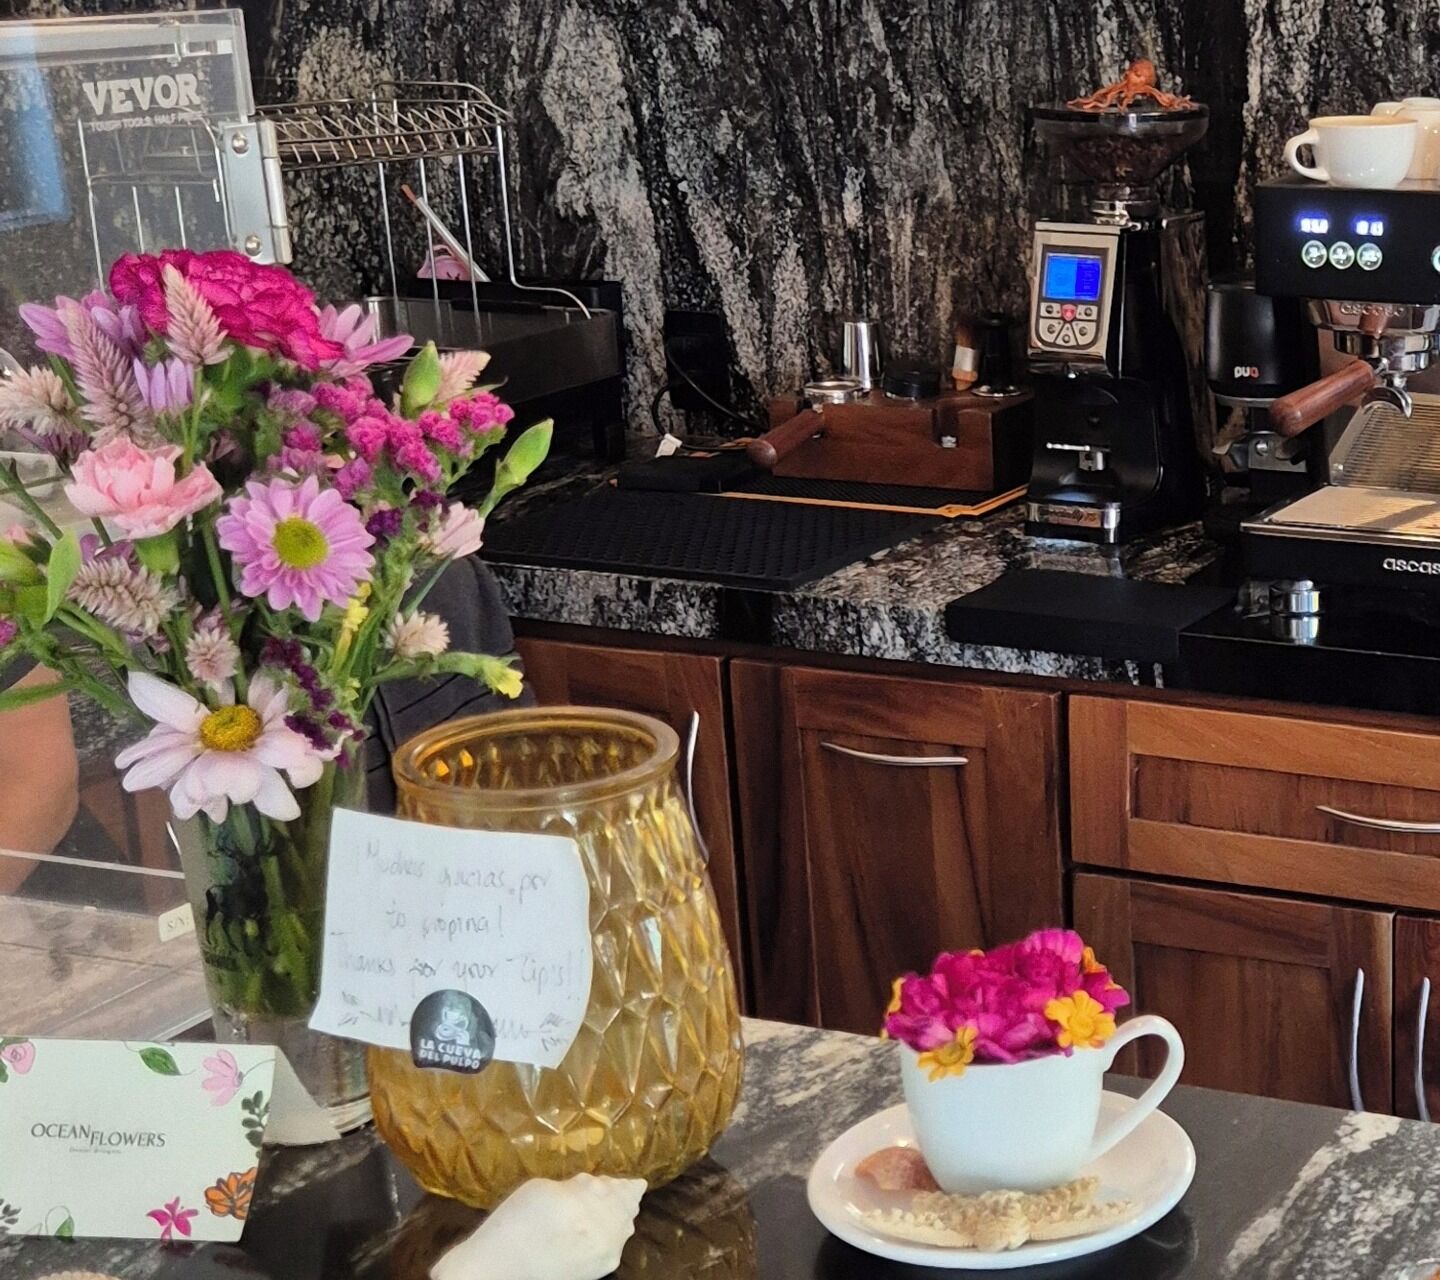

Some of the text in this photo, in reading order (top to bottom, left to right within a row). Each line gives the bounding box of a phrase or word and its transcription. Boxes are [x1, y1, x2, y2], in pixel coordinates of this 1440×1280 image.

[82, 73, 201, 115] VEVOR
[418, 1049, 481, 1070] DEL PULPO
[420, 1038, 481, 1060] LA CUEVA
